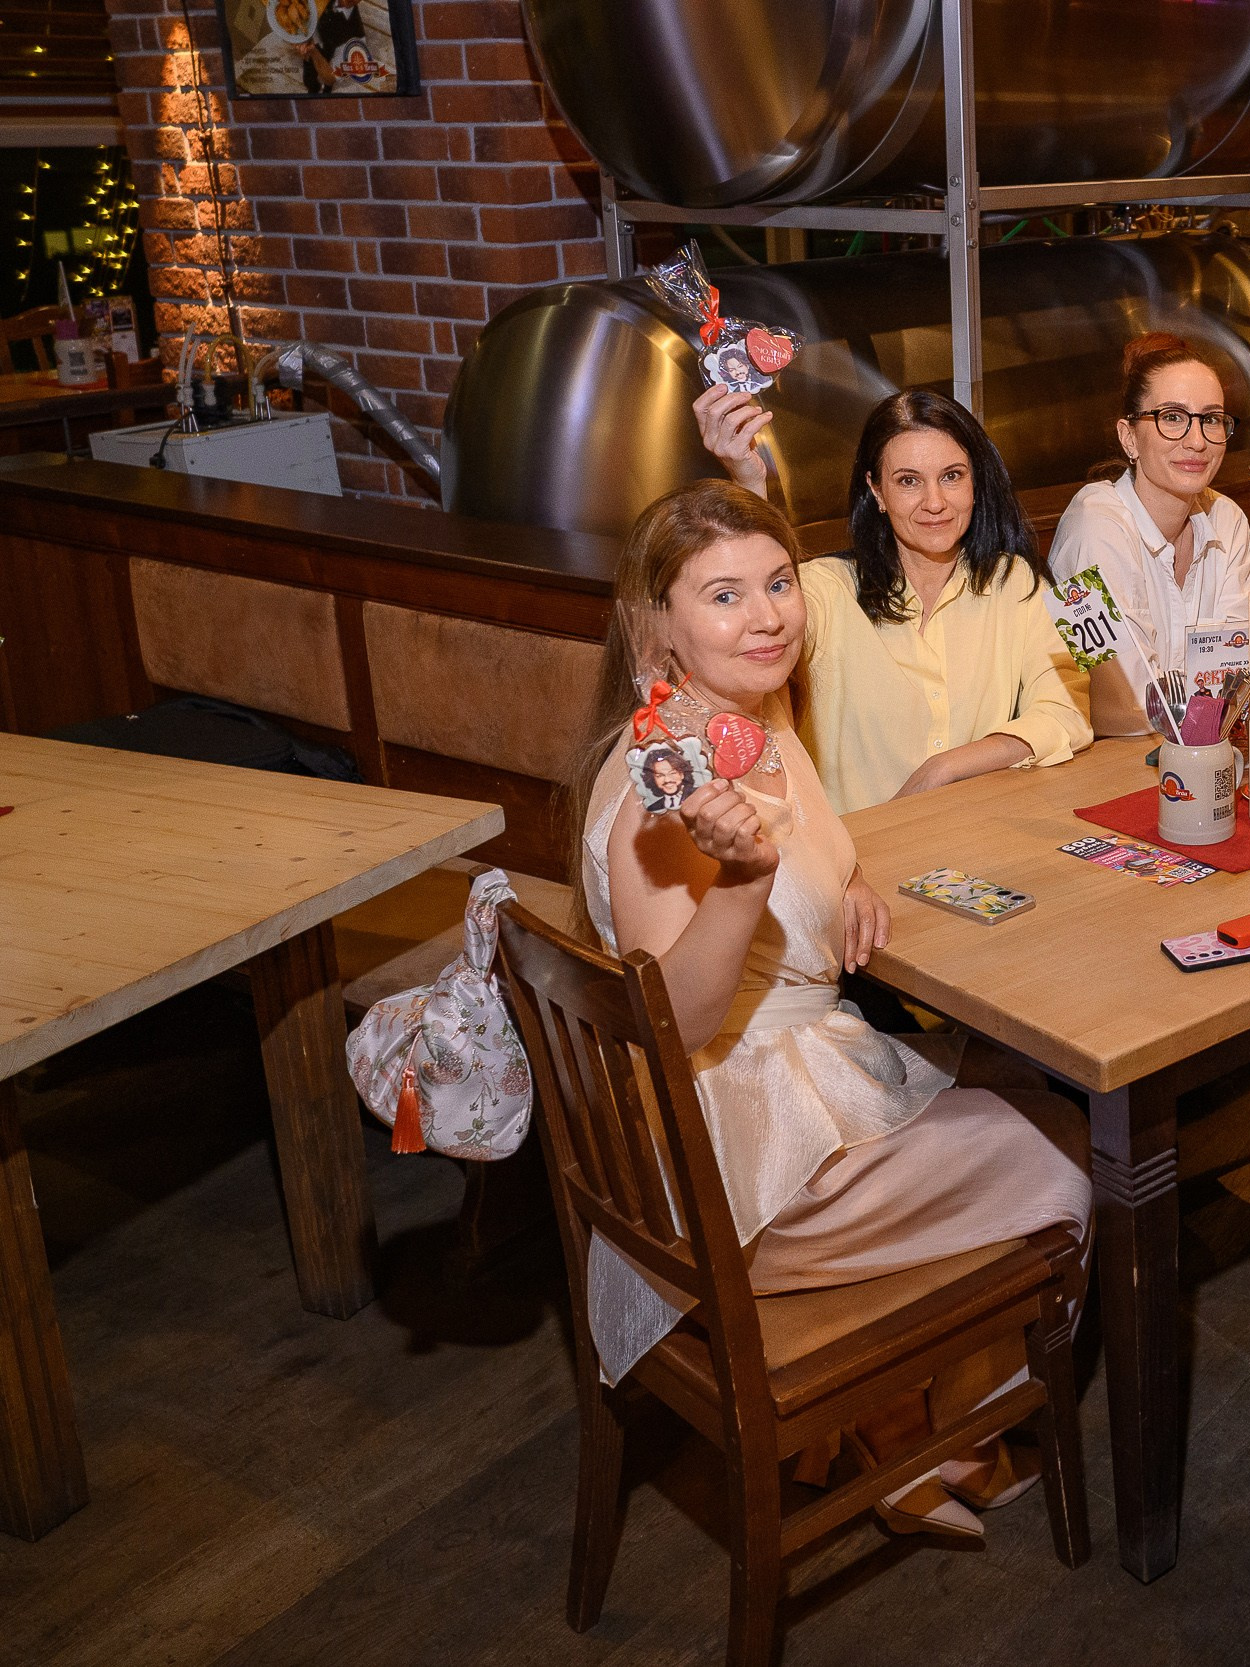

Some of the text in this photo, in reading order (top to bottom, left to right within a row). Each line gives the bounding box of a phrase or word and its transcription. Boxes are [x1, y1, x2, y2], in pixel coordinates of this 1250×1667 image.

[1071, 610, 1118, 655] 201
[1198, 635, 1222, 644] АВГУСТА
[1199, 645, 1214, 653] 19:30
[1061, 837, 1097, 851] 600
